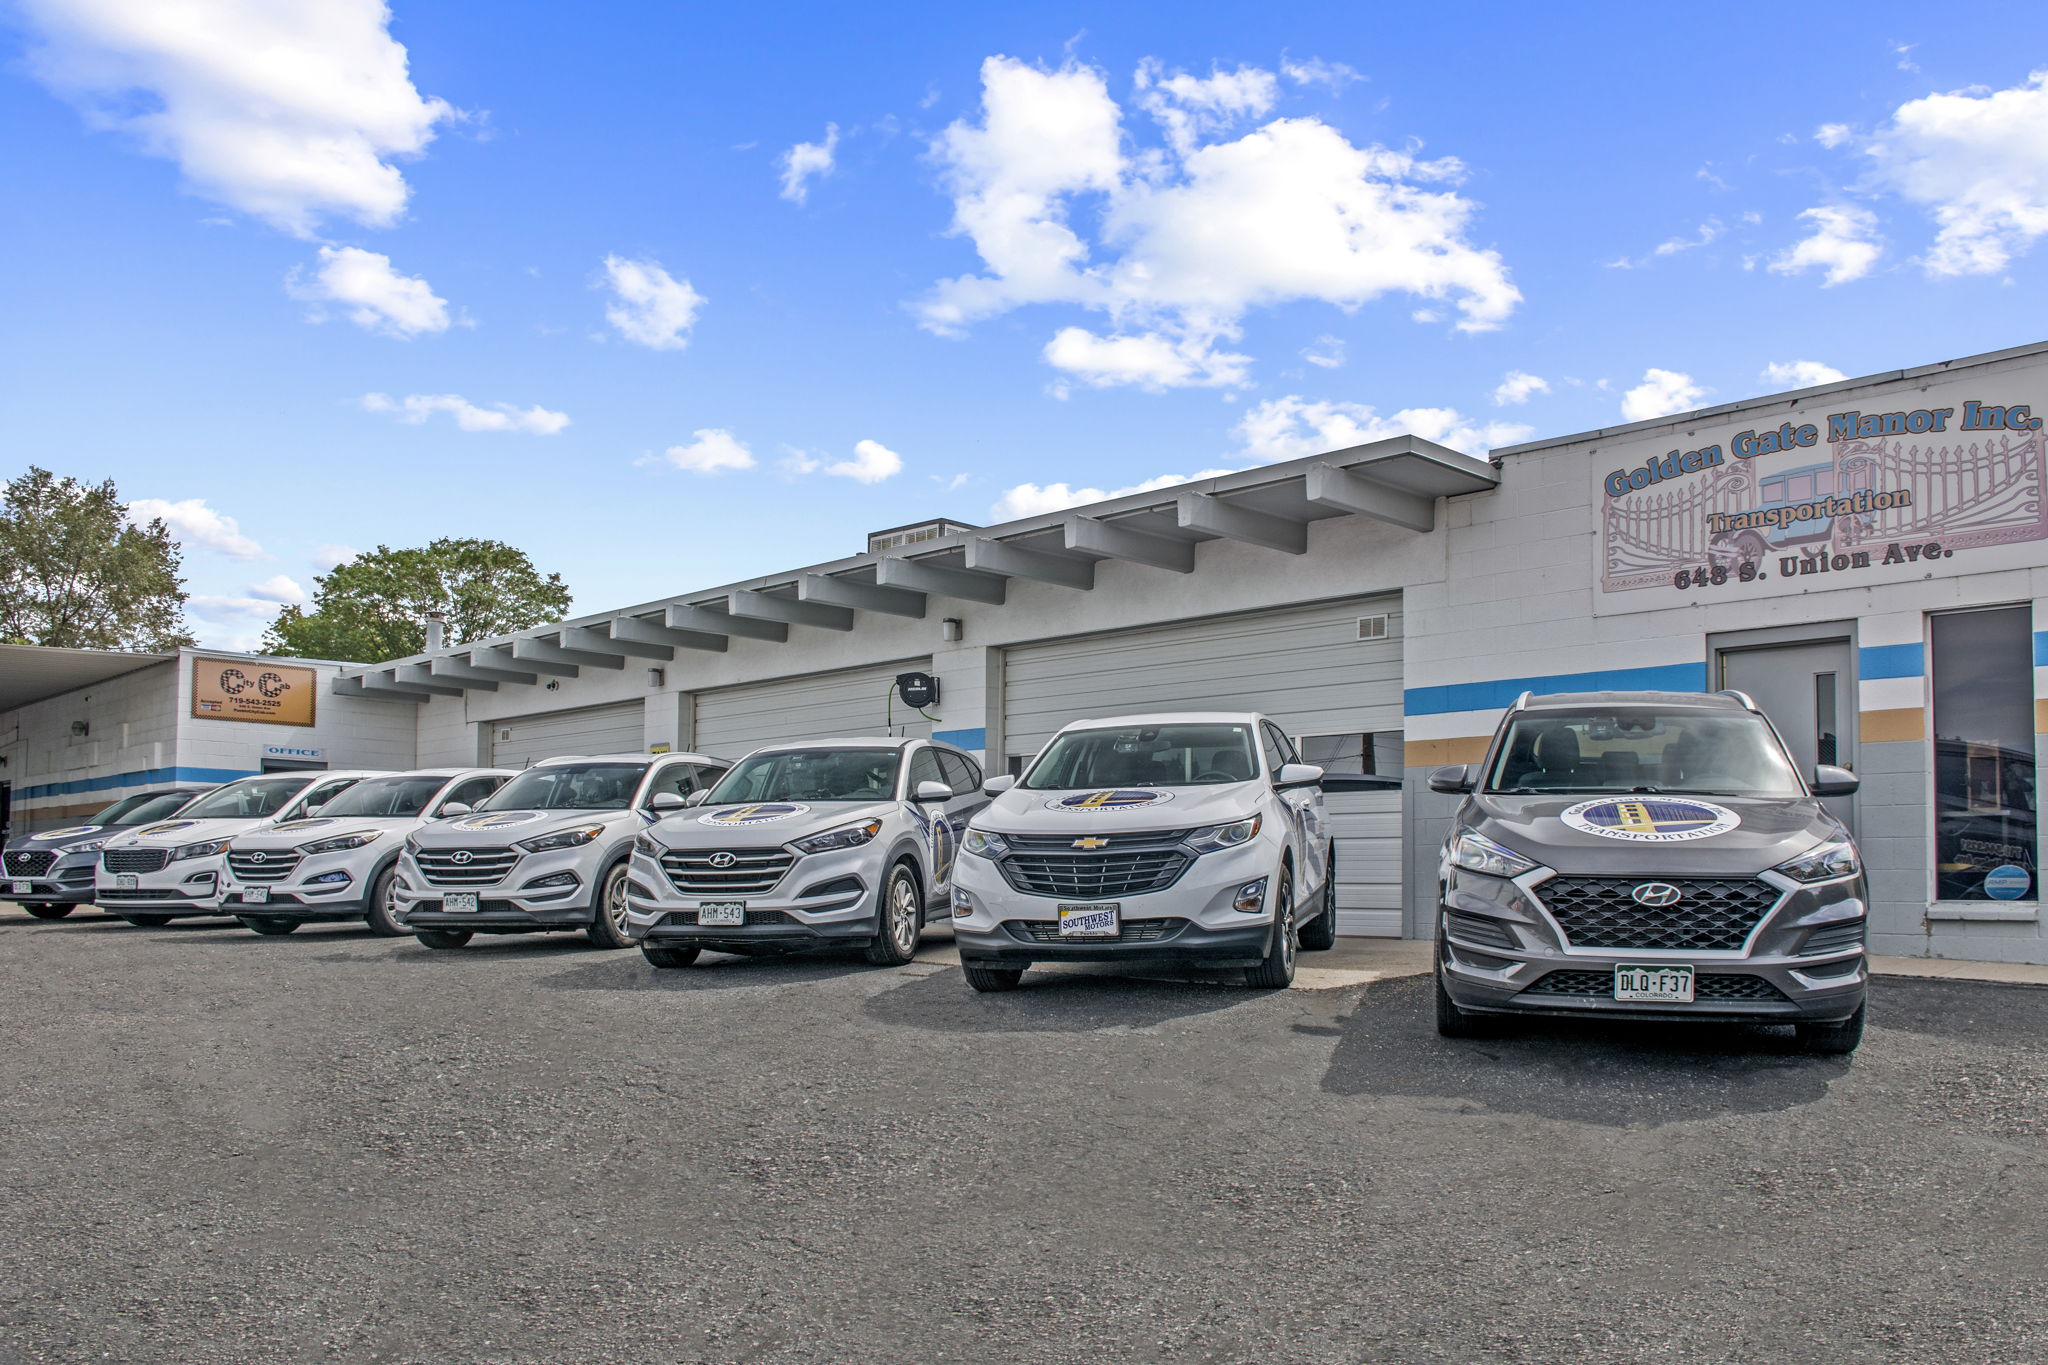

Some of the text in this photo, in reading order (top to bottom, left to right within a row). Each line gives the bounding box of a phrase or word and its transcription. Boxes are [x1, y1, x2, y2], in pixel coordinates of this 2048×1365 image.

[1604, 400, 2043, 498] Golden Gate Manor Inc.
[1707, 488, 1912, 534] Transportation
[1673, 541, 1954, 590] 648 S. Union Ave.
[220, 668, 291, 698] City Cab
[268, 747, 320, 756] OFFICE
[1577, 822, 1731, 841] TRANSPORTATION
[701, 907, 741, 919] AHM-543
[1062, 910, 1114, 929] SOUTHWEST
[1084, 919, 1114, 931] MOTORS
[1620, 974, 1689, 992] DLQ-F37
[1635, 991, 1674, 999] COLORADO
